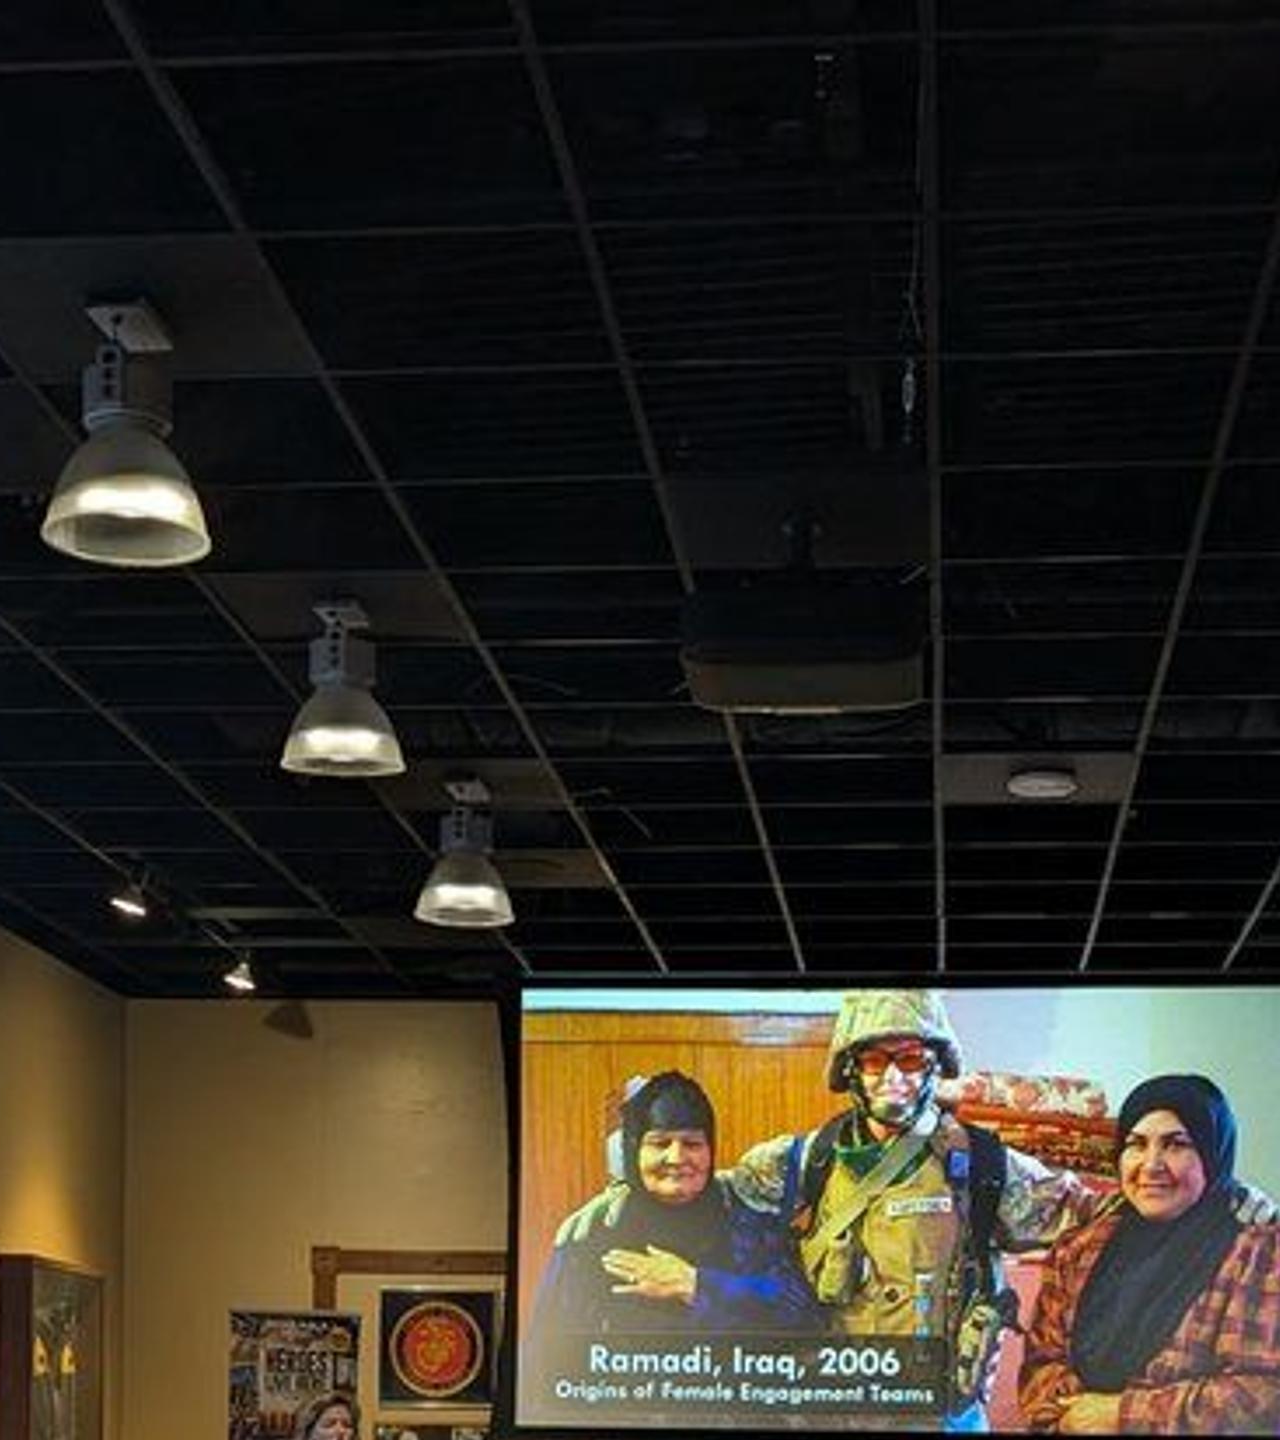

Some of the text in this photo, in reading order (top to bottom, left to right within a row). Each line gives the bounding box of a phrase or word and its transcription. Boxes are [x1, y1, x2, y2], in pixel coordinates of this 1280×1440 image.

[589, 1344, 901, 1381] Ramadi, Iraq, 2006
[555, 1378, 935, 1404] Origins of Female Engagement Teams
